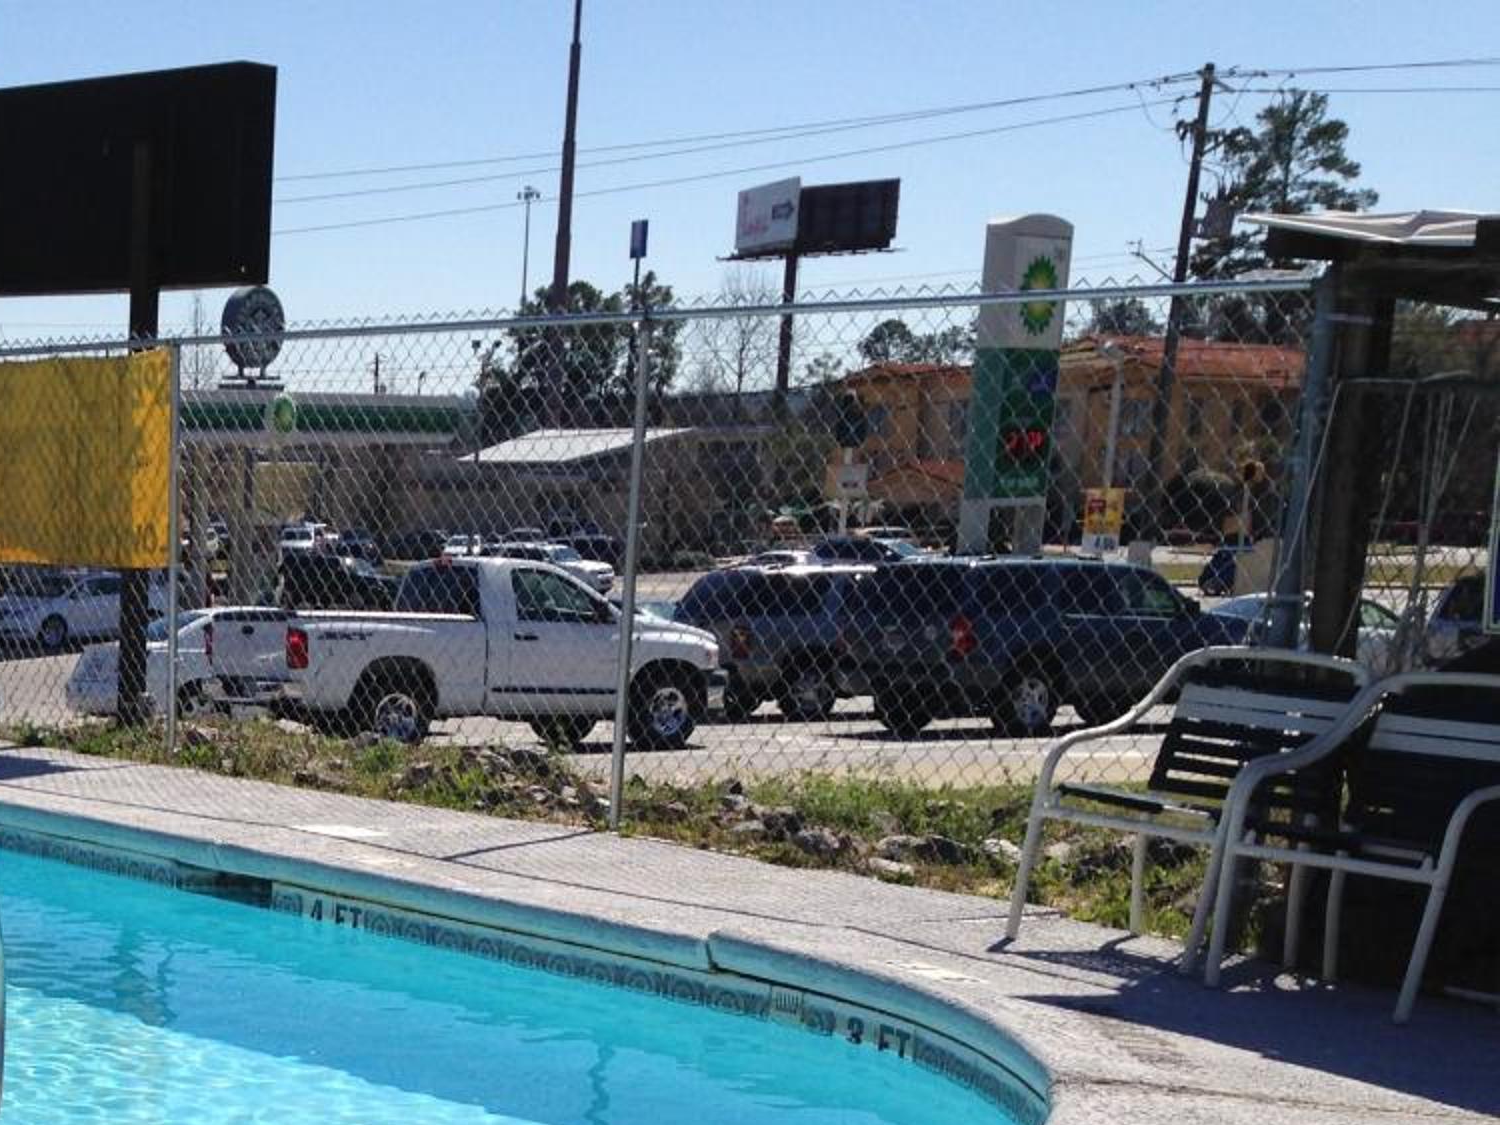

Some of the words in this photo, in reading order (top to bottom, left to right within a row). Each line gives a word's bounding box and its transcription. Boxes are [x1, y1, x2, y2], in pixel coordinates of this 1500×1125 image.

[310, 898, 323, 921] 4
[335, 903, 362, 928] FT
[845, 1017, 864, 1044] 3
[878, 1024, 911, 1058] FT
